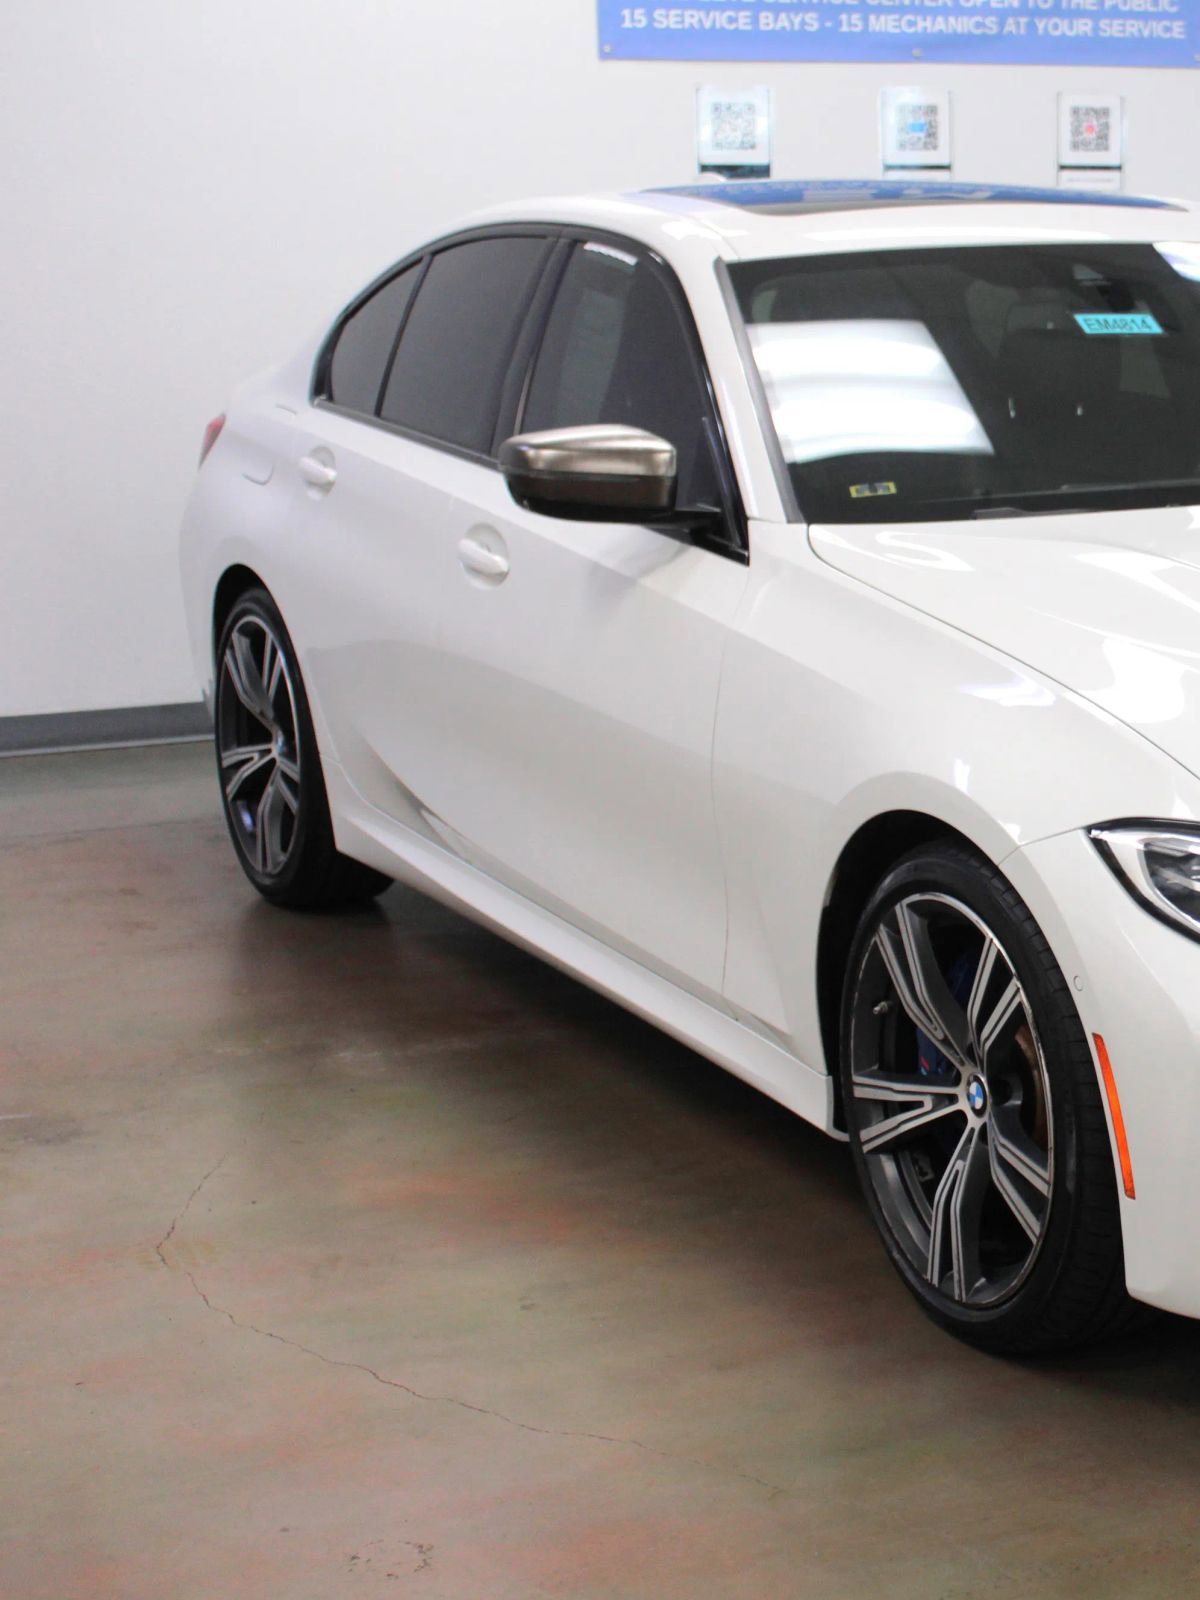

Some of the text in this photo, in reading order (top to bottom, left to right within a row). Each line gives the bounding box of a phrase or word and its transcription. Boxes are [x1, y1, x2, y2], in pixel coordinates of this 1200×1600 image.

[621, 9, 647, 28] 15
[653, 9, 751, 30] SERVICE
[759, 11, 819, 32] BAYS
[838, 14, 863, 32] 15
[868, 14, 998, 37] MECHANICS
[1003, 17, 1028, 35] AT
[1035, 17, 1092, 37] YOUR
[1098, 19, 1187, 39] SERVICE
